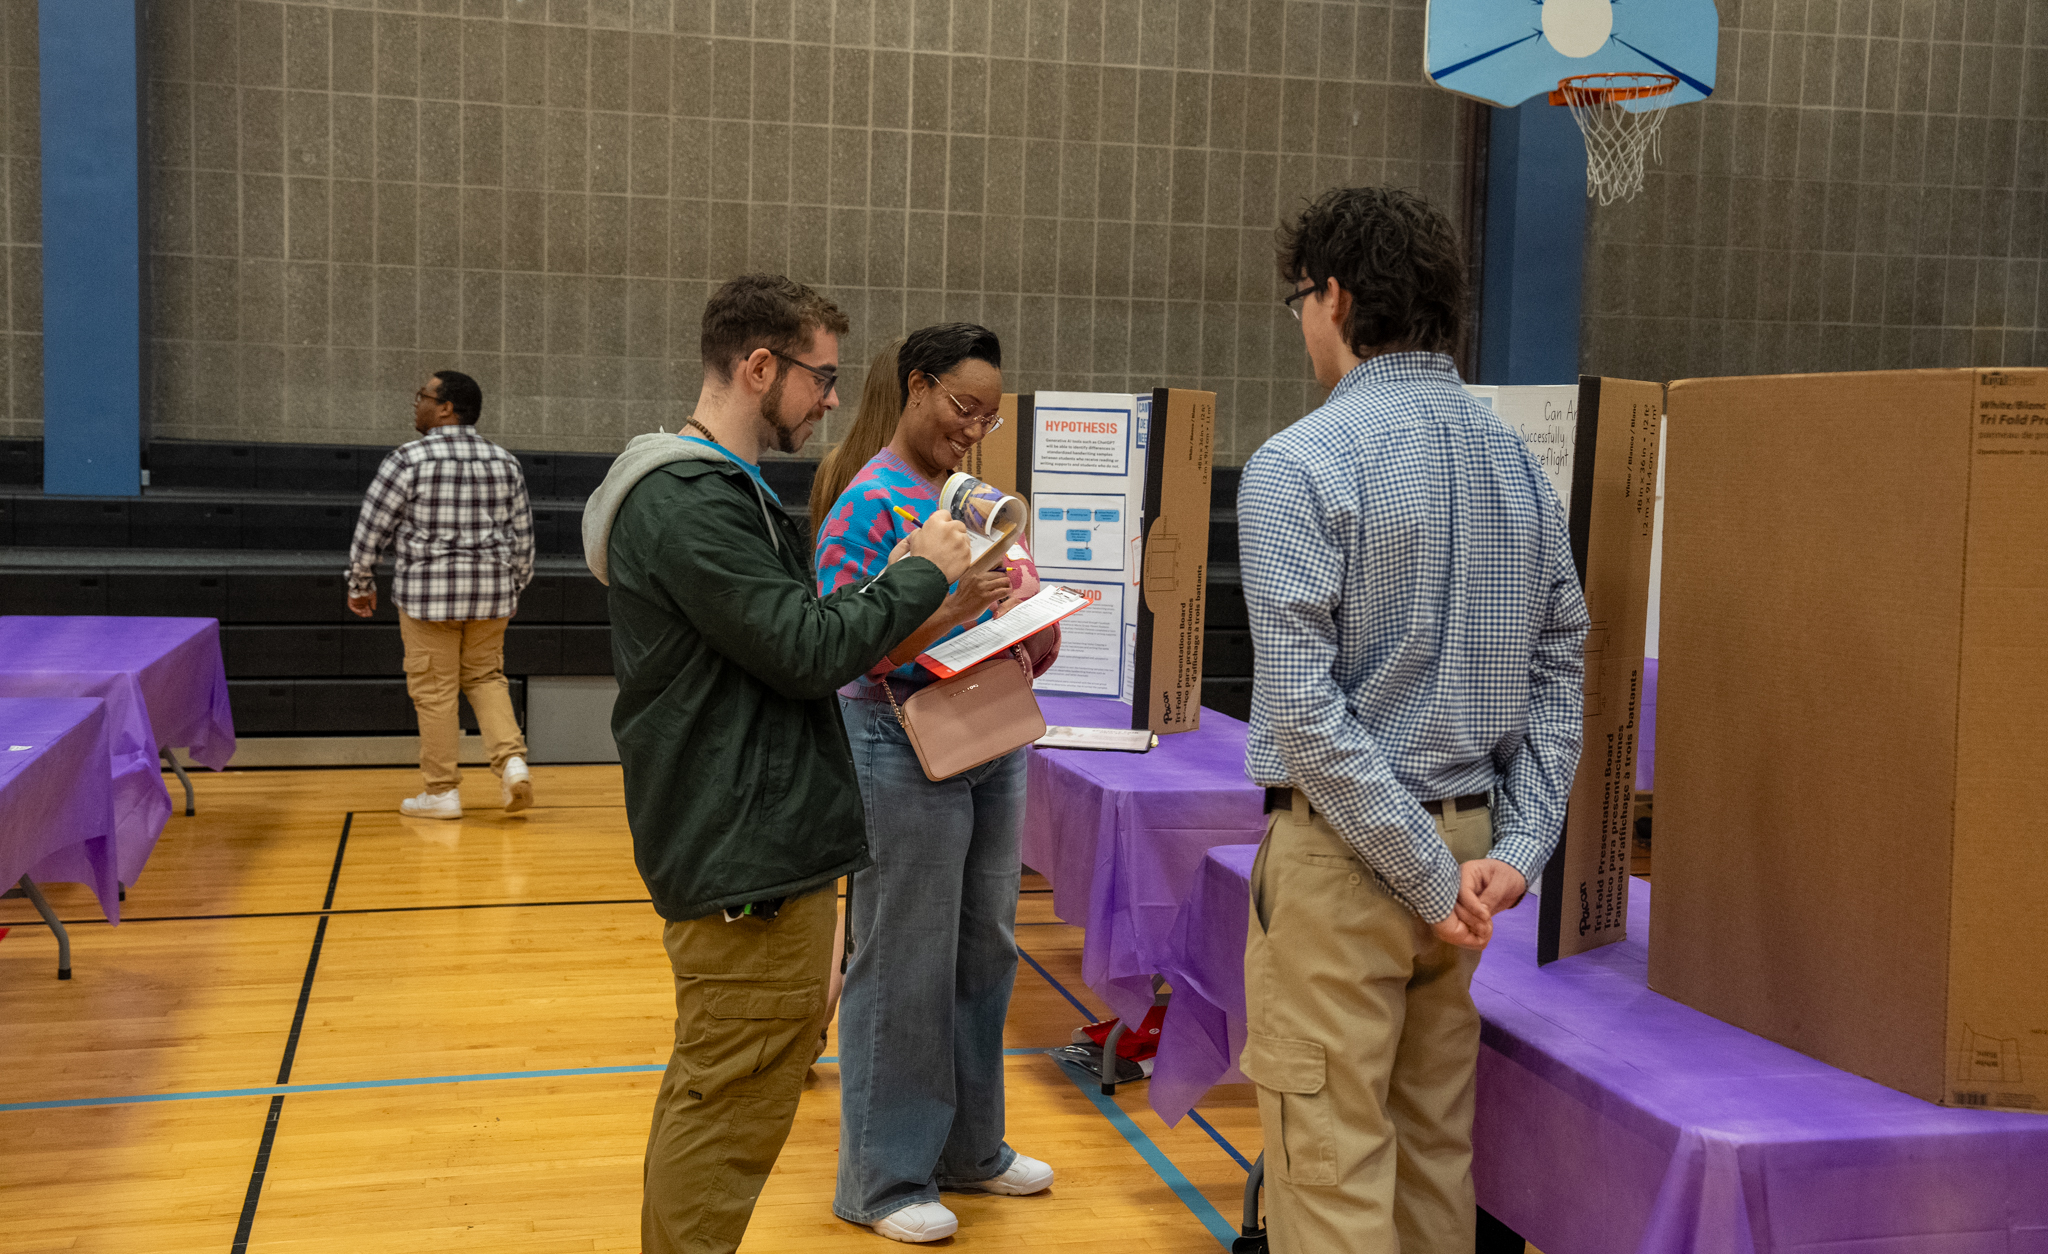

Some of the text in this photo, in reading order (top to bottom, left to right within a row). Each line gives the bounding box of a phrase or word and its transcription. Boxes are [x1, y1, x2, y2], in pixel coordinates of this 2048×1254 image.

[1045, 420, 1118, 434] HYPOTHESIS
[1544, 401, 1562, 421] Can
[1643, 419, 1649, 430] 12
[1520, 423, 1565, 449] Successfully
[1641, 447, 1647, 457] in
[1640, 459, 1646, 472] 36
[1648, 452, 1654, 470] cm
[1636, 499, 1643, 514] 48
[1638, 487, 1644, 497] in
[1195, 565, 1203, 601] battants
[1185, 598, 1194, 665] presentaciones
[1177, 632, 1185, 689] Presentation
[1163, 691, 1173, 725] Pacon
[1625, 669, 1638, 729] battants
[1624, 733, 1633, 767] trois
[1610, 724, 1624, 834] presentaciones
[1594, 733, 1615, 934] Tri-Fold Presentation Board
[1616, 785, 1630, 861] d'affichage
[1608, 840, 1618, 871] para
[1579, 881, 1591, 937] Pacon
[1613, 866, 1624, 928] Panneau
